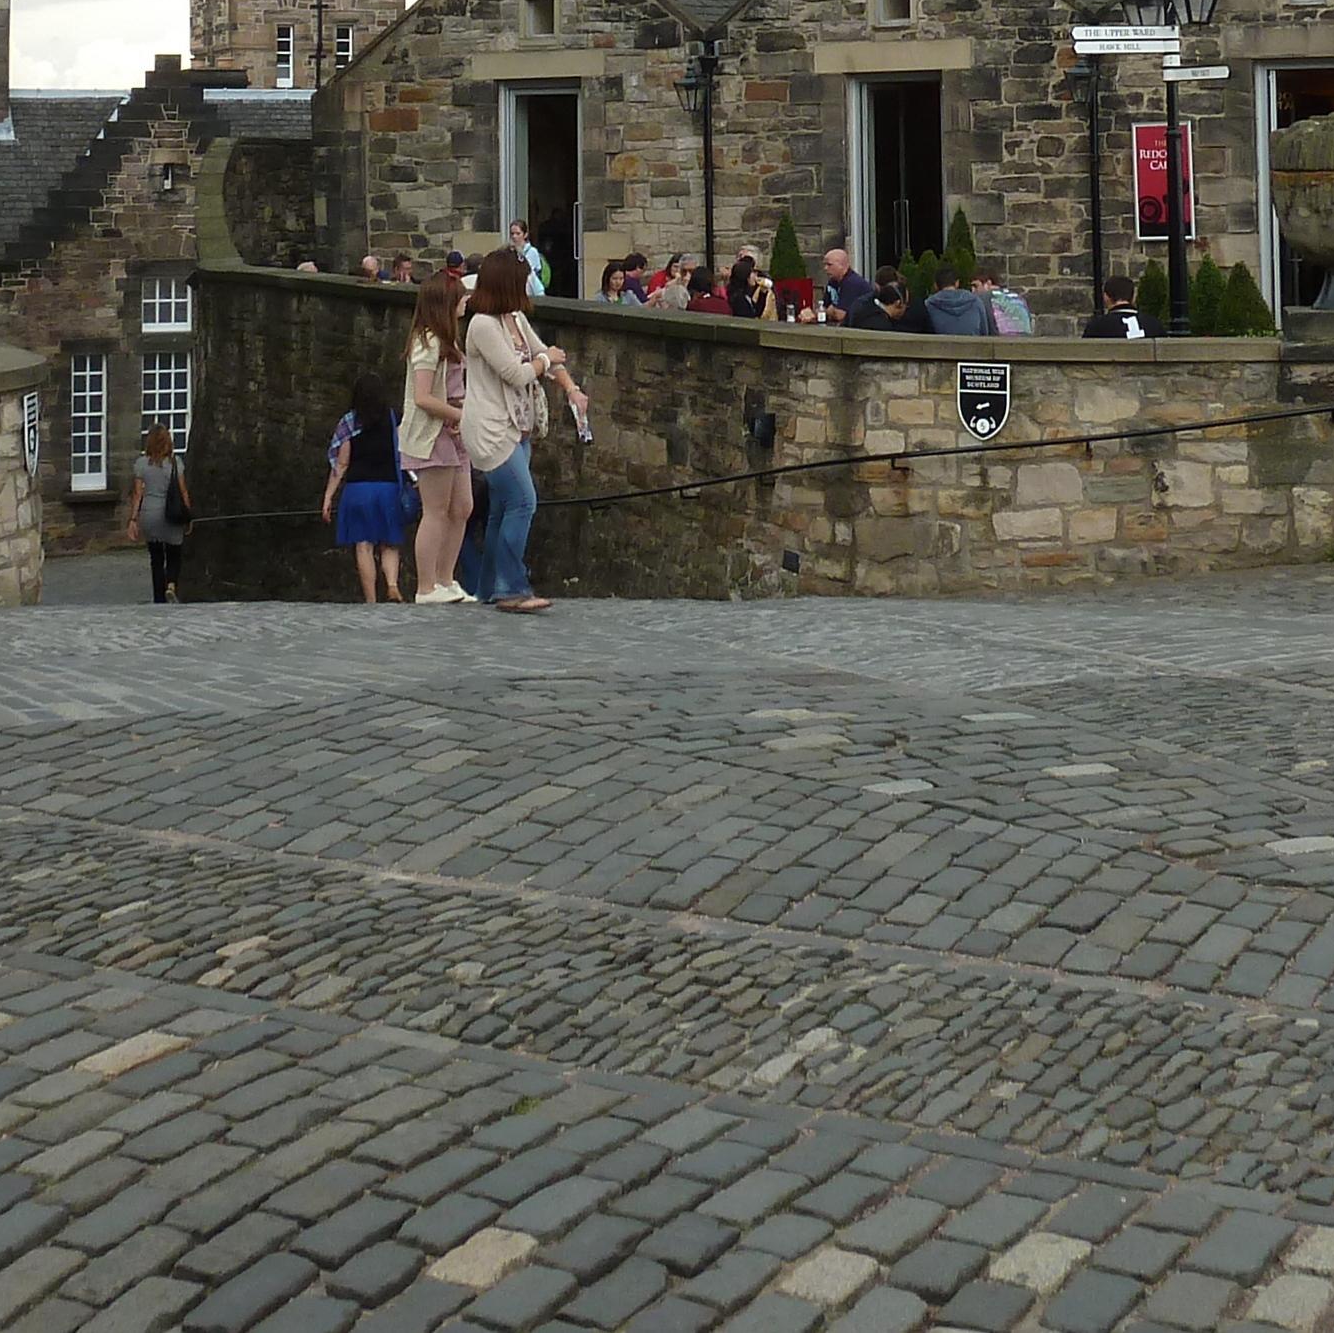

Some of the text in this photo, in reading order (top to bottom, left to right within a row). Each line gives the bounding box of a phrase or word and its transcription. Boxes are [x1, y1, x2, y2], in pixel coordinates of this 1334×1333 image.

[1104, 28, 1130, 37] UPPER
[1132, 28, 1156, 36] WARD
[1139, 149, 1167, 159] REDCO
[1121, 315, 1146, 339] 1
[967, 381, 1000, 389] SCOTLAND
